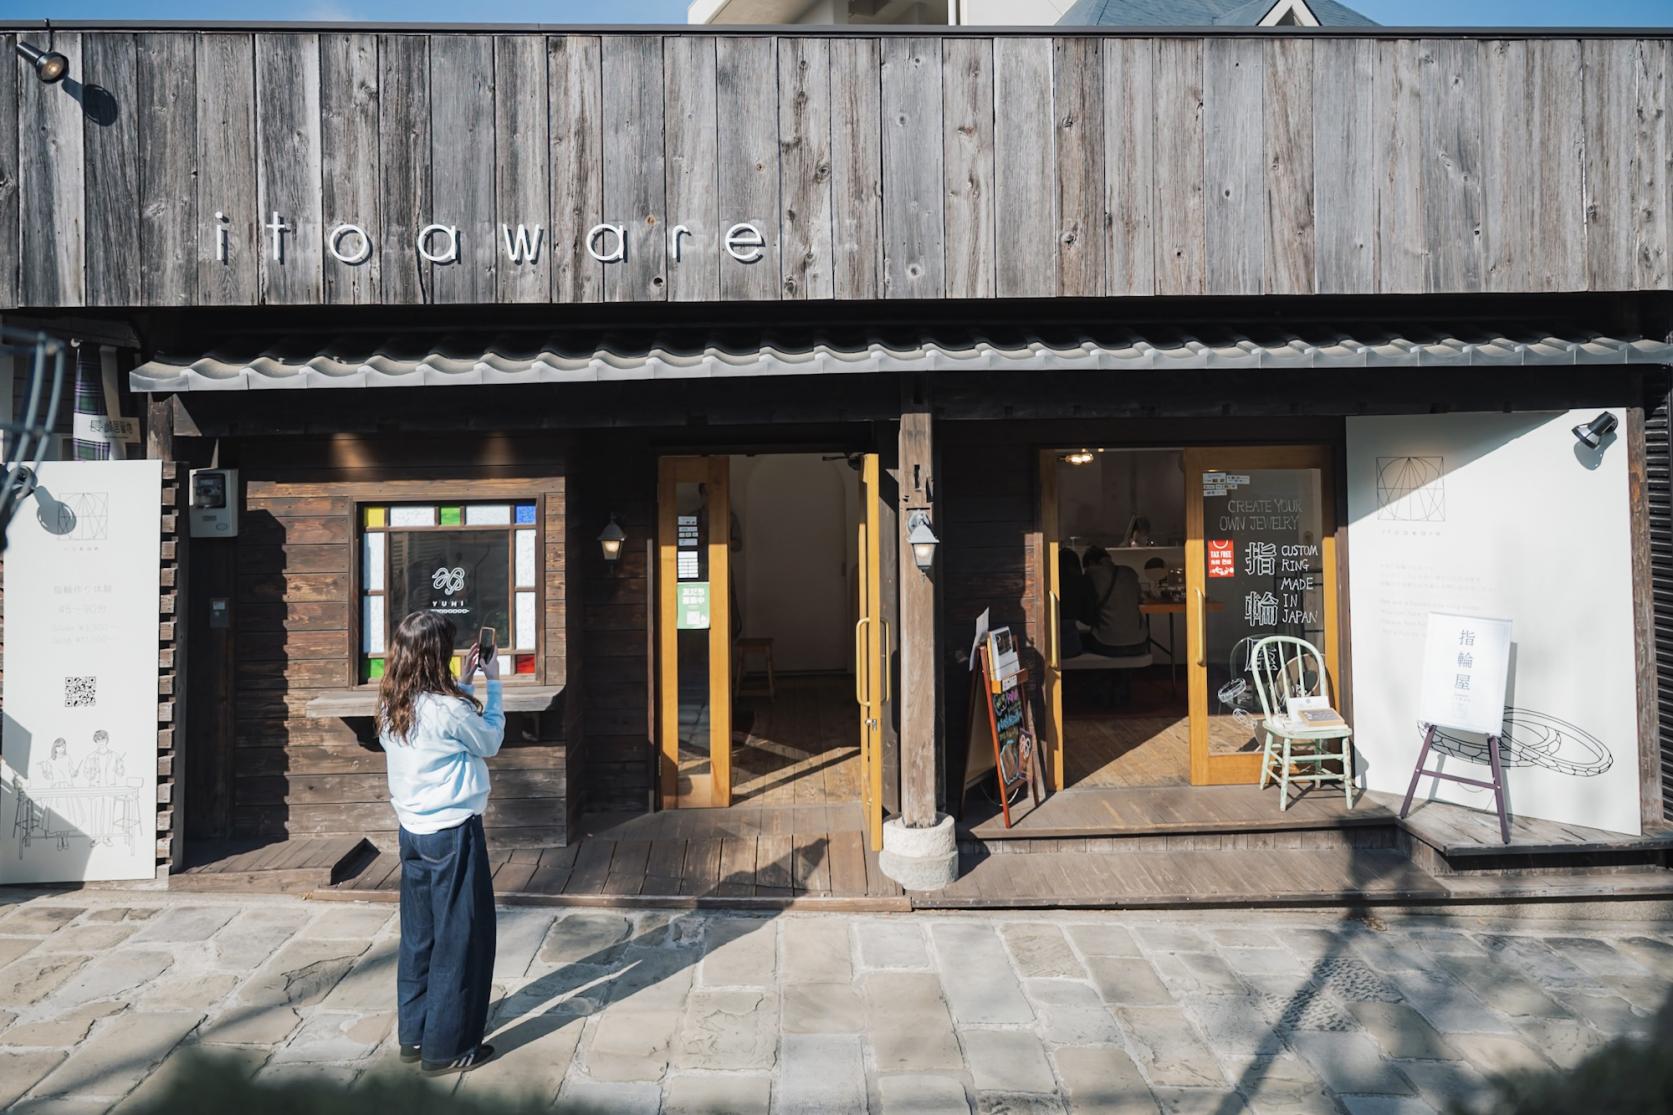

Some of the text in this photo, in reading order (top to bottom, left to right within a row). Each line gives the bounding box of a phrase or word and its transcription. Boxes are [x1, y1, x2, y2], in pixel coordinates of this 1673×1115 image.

[1228, 499, 1303, 513] CREATE YOUR
[1220, 516, 1299, 531] OWN JEWELRY
[1281, 545, 1318, 557] CUSTOM
[1281, 559, 1310, 572] RING
[1280, 577, 1314, 590] MADE
[1283, 594, 1298, 608] IN
[1281, 610, 1319, 624] JAPAN
[1455, 629, 1475, 690] 指輪屋
